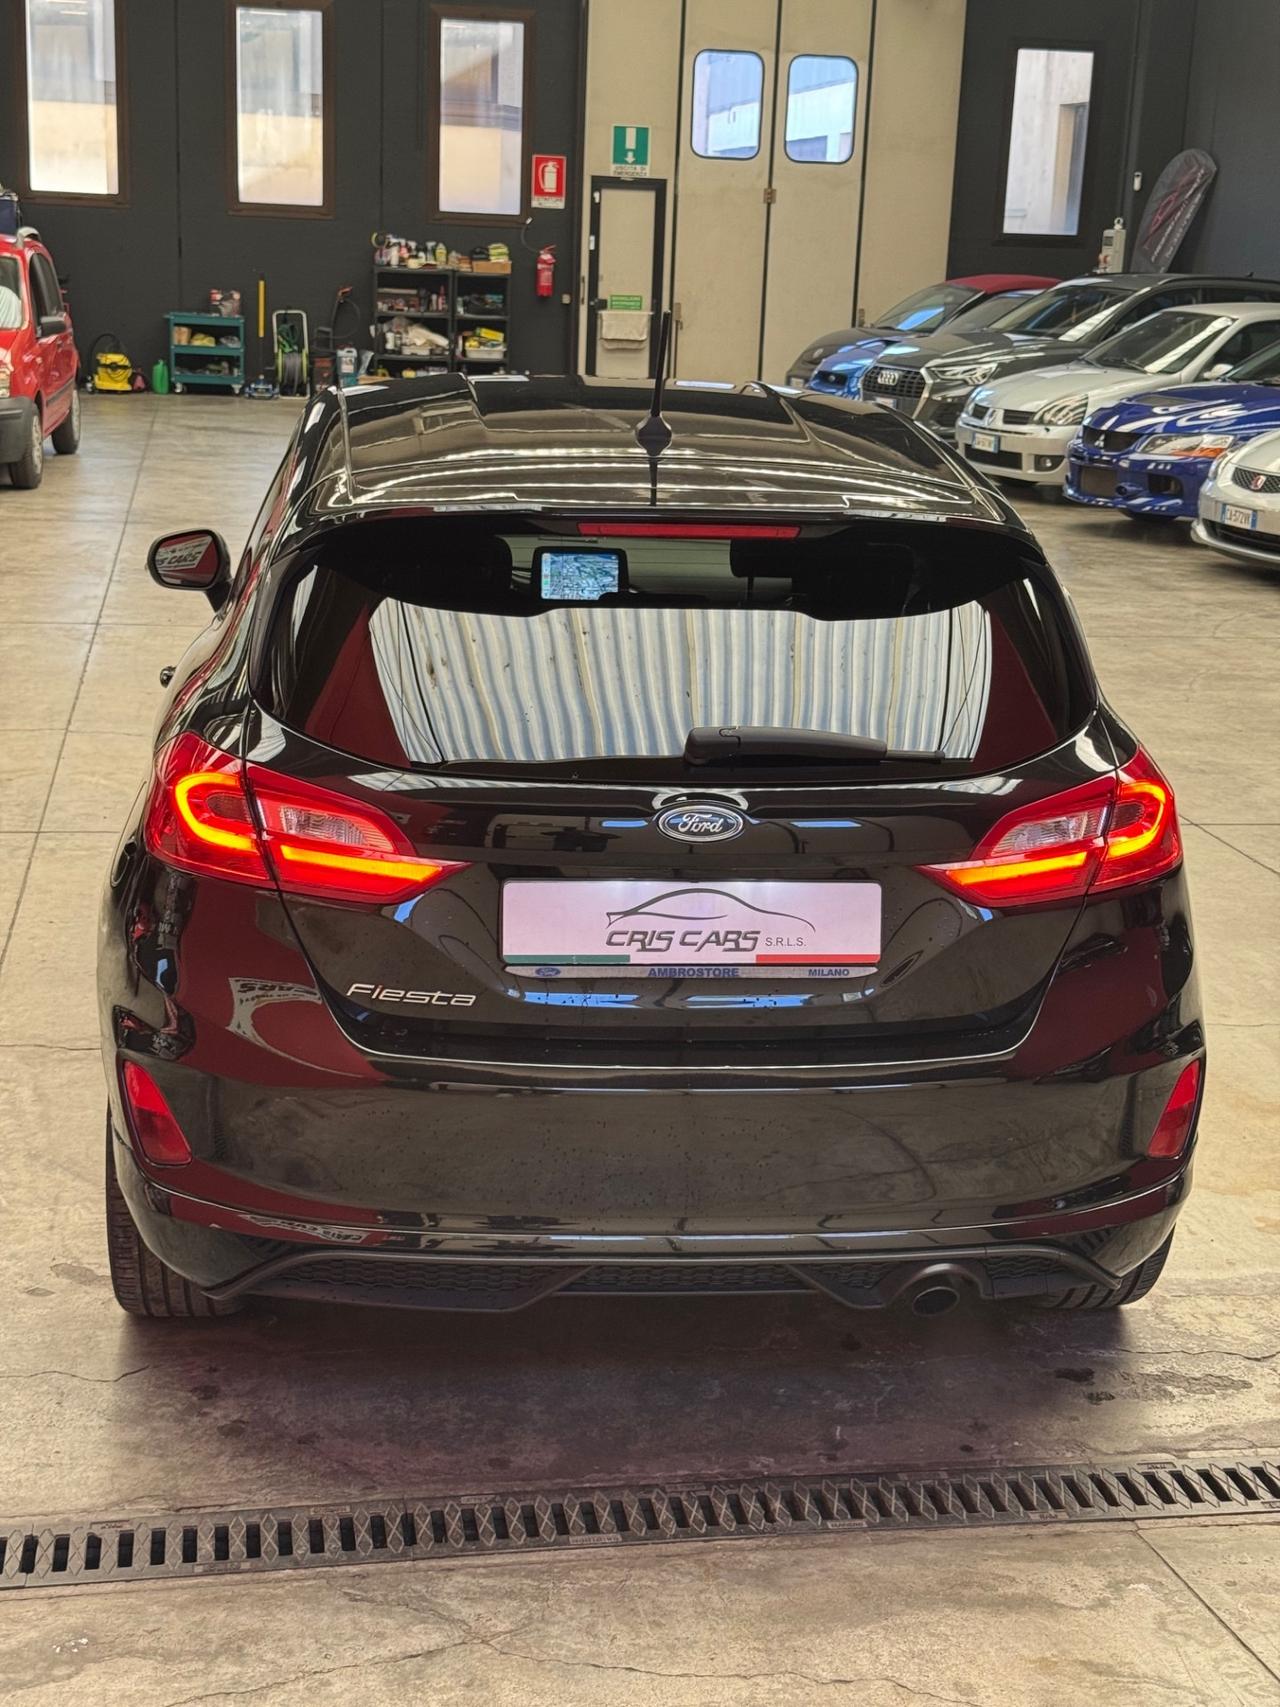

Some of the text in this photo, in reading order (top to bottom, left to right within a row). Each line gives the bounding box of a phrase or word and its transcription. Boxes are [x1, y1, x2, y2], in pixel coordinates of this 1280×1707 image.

[678, 812, 724, 833] Ford
[606, 929, 807, 952] CRIS CARS S.R.L.S.
[648, 967, 739, 977] AMBROSTORE
[808, 967, 850, 977] MILANO
[346, 983, 477, 1006] Fiesta
